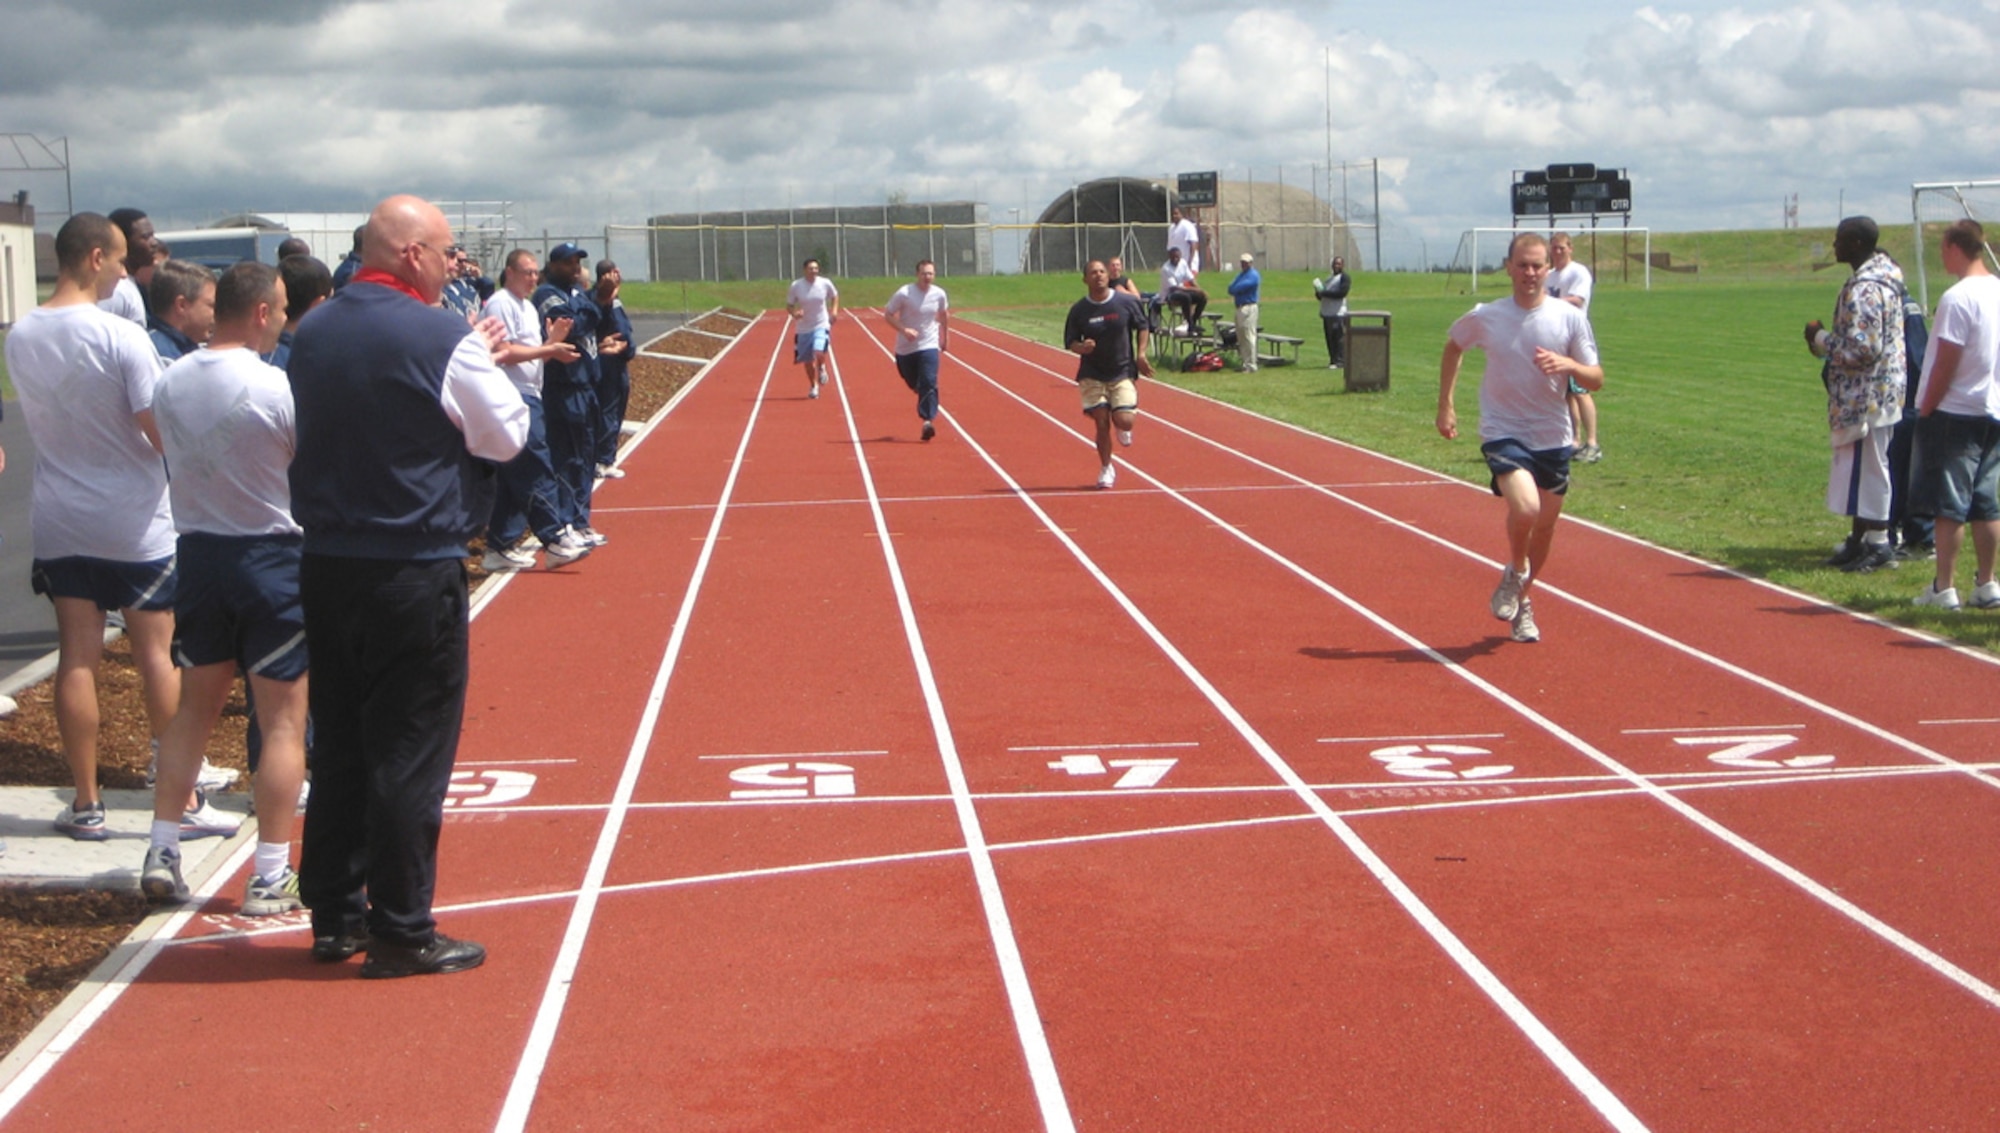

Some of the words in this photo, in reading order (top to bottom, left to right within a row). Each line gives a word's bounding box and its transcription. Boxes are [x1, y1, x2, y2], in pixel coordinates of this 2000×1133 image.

[1517, 184, 1548, 196] HOME
[1369, 744, 1515, 779] 3
[1672, 734, 1836, 768] 2
[728, 762, 856, 799] 5
[1046, 754, 1179, 788] 4
